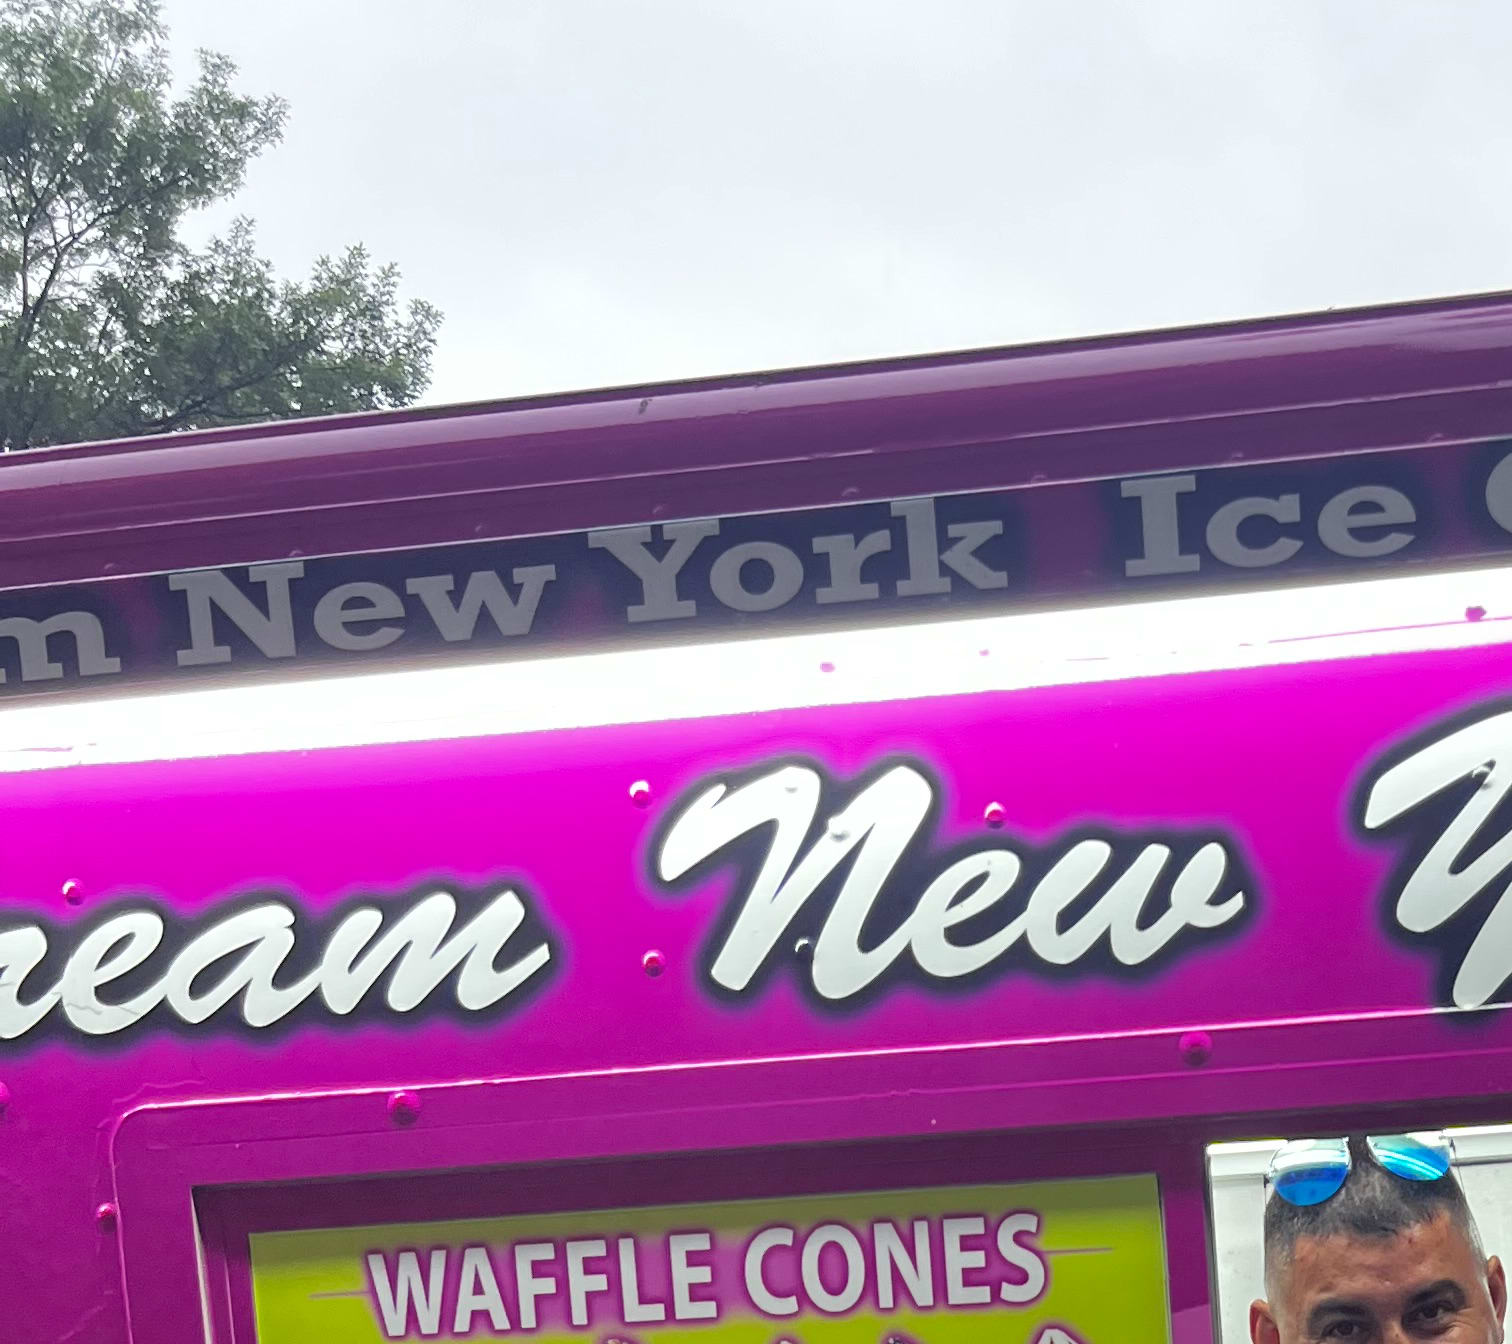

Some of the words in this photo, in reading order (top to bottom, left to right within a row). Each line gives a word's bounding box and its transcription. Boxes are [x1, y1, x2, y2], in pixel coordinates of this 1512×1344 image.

[168, 562, 556, 667] New
[587, 496, 1008, 624] York
[1120, 474, 1417, 577] Ice
[659, 765, 1245, 1000] New
[366, 1232, 718, 1336] WAFFLE
[744, 1213, 1047, 1317] CONES
